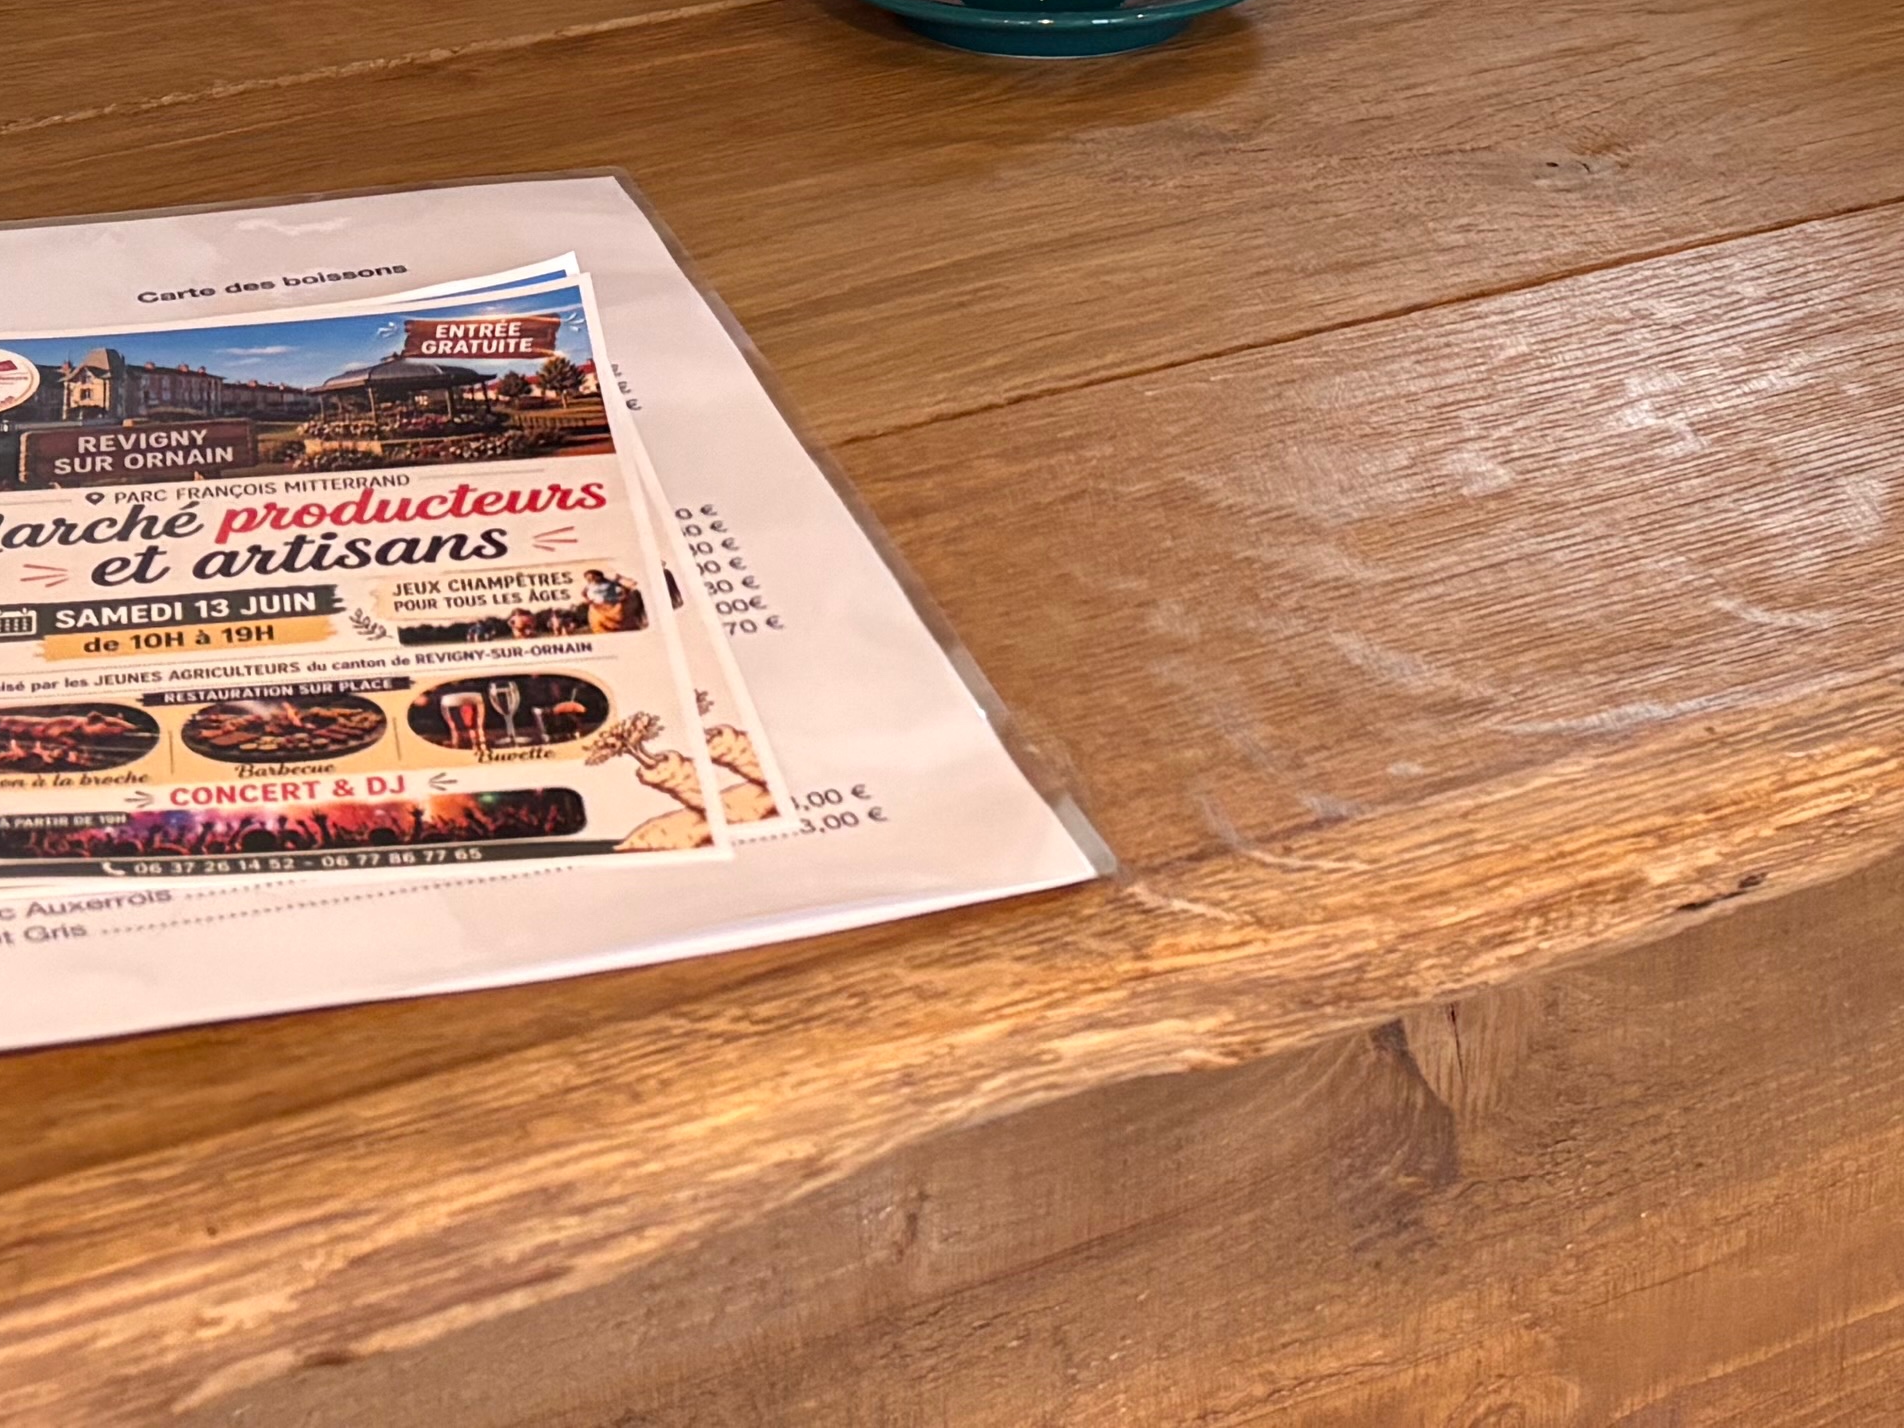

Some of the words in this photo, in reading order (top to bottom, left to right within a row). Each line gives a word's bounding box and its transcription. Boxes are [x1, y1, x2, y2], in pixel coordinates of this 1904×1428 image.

[137, 284, 218, 306] Carte
[224, 277, 276, 296] des
[283, 263, 409, 288] boissons
[435, 318, 521, 340] ENTRÉE
[421, 336, 533, 356] GRATUITE
[77, 429, 209, 454] REVIGNY
[54, 455, 118, 476] SUR
[123, 447, 234, 471] ORNAIN
[115, 487, 169, 505] PARC
[176, 481, 277, 502] FRANÇOIS
[283, 473, 410, 494] MITTERRAND
[215, 477, 607, 545] producteurs
[90, 548, 172, 589] et
[192, 527, 510, 581] artisans
[392, 579, 442, 597] JEUX
[448, 569, 573, 593] CHAMPÊTRES
[54, 603, 183, 630] SAMEDI
[192, 598, 232, 619] 13
[239, 592, 317, 616] JUIN
[394, 597, 436, 612] POUR
[442, 595, 487, 609] TOUS
[492, 592, 522, 607] LES
[527, 584, 571, 604] ÂGES
[82, 635, 118, 654] de
[129, 631, 185, 651] 10H
[194, 628, 210, 648] à
[221, 625, 275, 644] 19H
[31, 679, 60, 694] par
[65, 676, 89, 688] les
[94, 671, 163, 687] JEUNES
[168, 662, 302, 682] AGRICULTEURS
[306, 662, 327, 673] du
[332, 659, 387, 670] canton
[391, 655, 411, 666] de
[415, 642, 592, 664] REVIGNY-SUR-ORNAIN
[164, 686, 294, 705] RESTAURATION
[299, 684, 333, 695] SUR
[339, 677, 393, 692] PLACE
[31, 774, 47, 788] à
[52, 772, 73, 786] la
[76, 771, 150, 786] broche
[234, 760, 337, 779] Barbecue
[170, 781, 322, 806] CONCERT
[332, 778, 357, 799] &
[366, 775, 406, 796] DJ
[25, 921, 88, 942] Gris
[800, 810, 861, 835] 3,00
[133, 861, 163, 875] 06
[169, 860, 198, 874] 37
[238, 857, 262, 872] 14
[268, 856, 295, 871] 52
[321, 854, 350, 868] 06
[355, 853, 381, 867] 77
[424, 848, 448, 862] 77
[26, 886, 173, 920] Auxerrois
